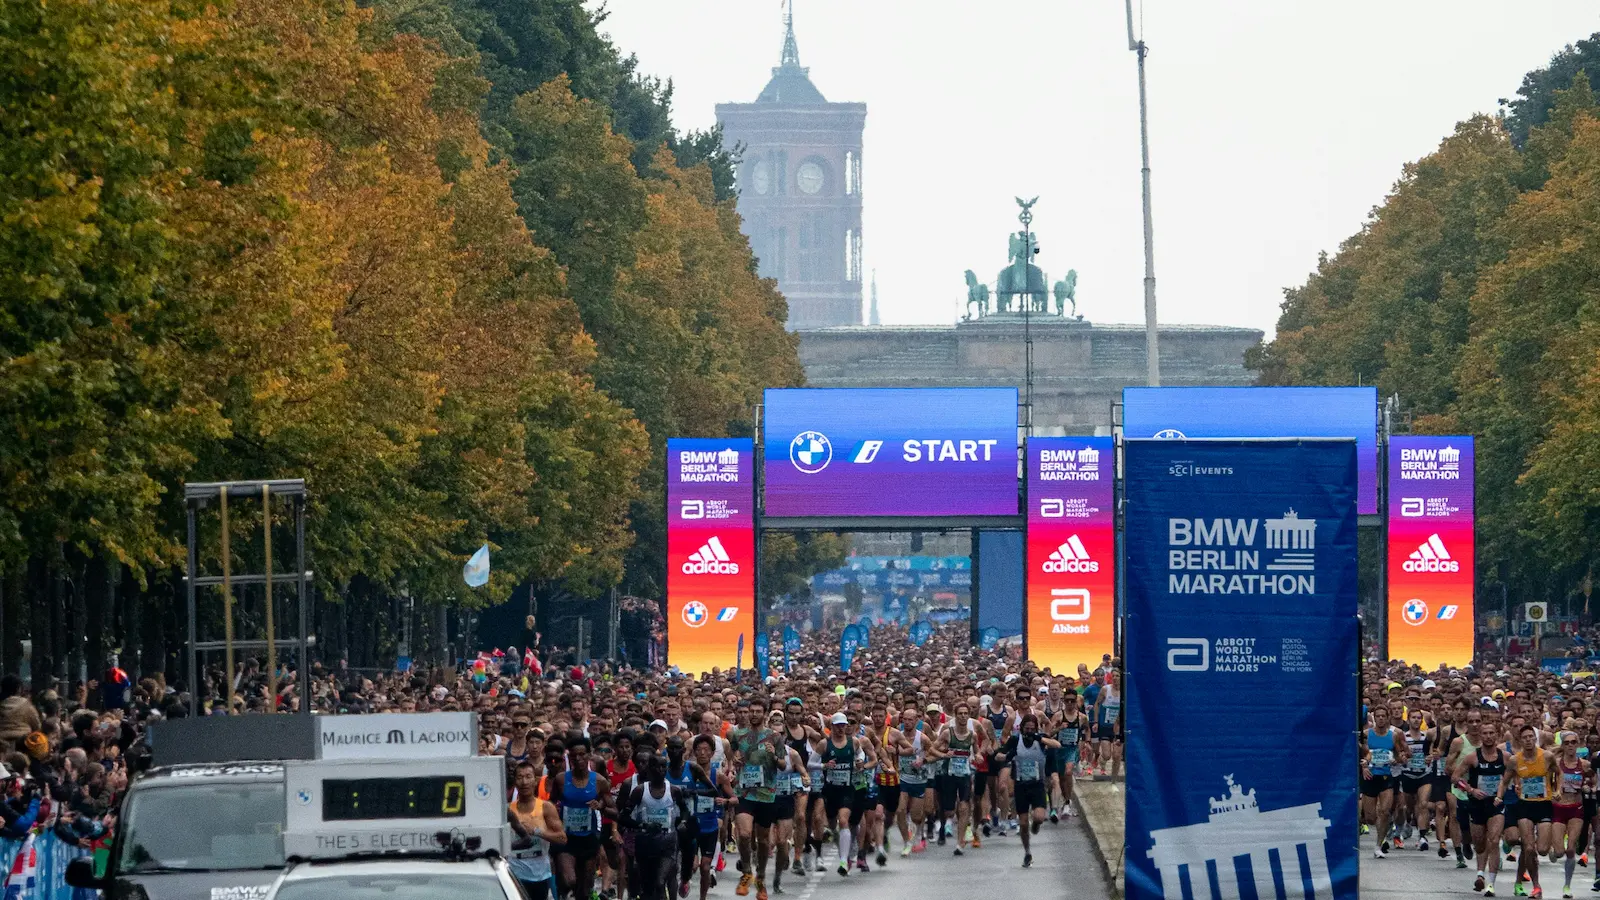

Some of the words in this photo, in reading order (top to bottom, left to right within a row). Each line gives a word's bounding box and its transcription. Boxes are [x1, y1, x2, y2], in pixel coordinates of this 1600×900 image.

[903, 439, 997, 462] START
[1040, 450, 1076, 462] BMW
[1401, 449, 1437, 461] BMW
[680, 451, 717, 464] BMW
[681, 464, 717, 473] BERLIN
[1040, 462, 1076, 471] BERLIN
[1169, 465, 1188, 476] SCC
[1195, 467, 1234, 475] EVENTS
[1401, 461, 1437, 470] BERLIN
[680, 473, 739, 482] MARATHON
[1040, 472, 1099, 480] MARATHON
[1401, 471, 1459, 480] MARATHON
[1169, 518, 1259, 546] BMW
[1042, 558, 1099, 573] adidas
[1169, 550, 1259, 570] BERLIN
[1402, 558, 1459, 573] adidas
[682, 559, 739, 574] adidas
[1169, 574, 1315, 594] MARATHON
[1052, 624, 1090, 634] Abbott
[1215, 638, 1256, 646] ABBOTT
[1215, 646, 1253, 655] WORLD
[1215, 655, 1277, 664] MARATHON
[1215, 664, 1259, 672] MAJORS
[441, 782, 464, 812] 0
[315, 835, 346, 848] THE
[211, 886, 258, 895] BMW
